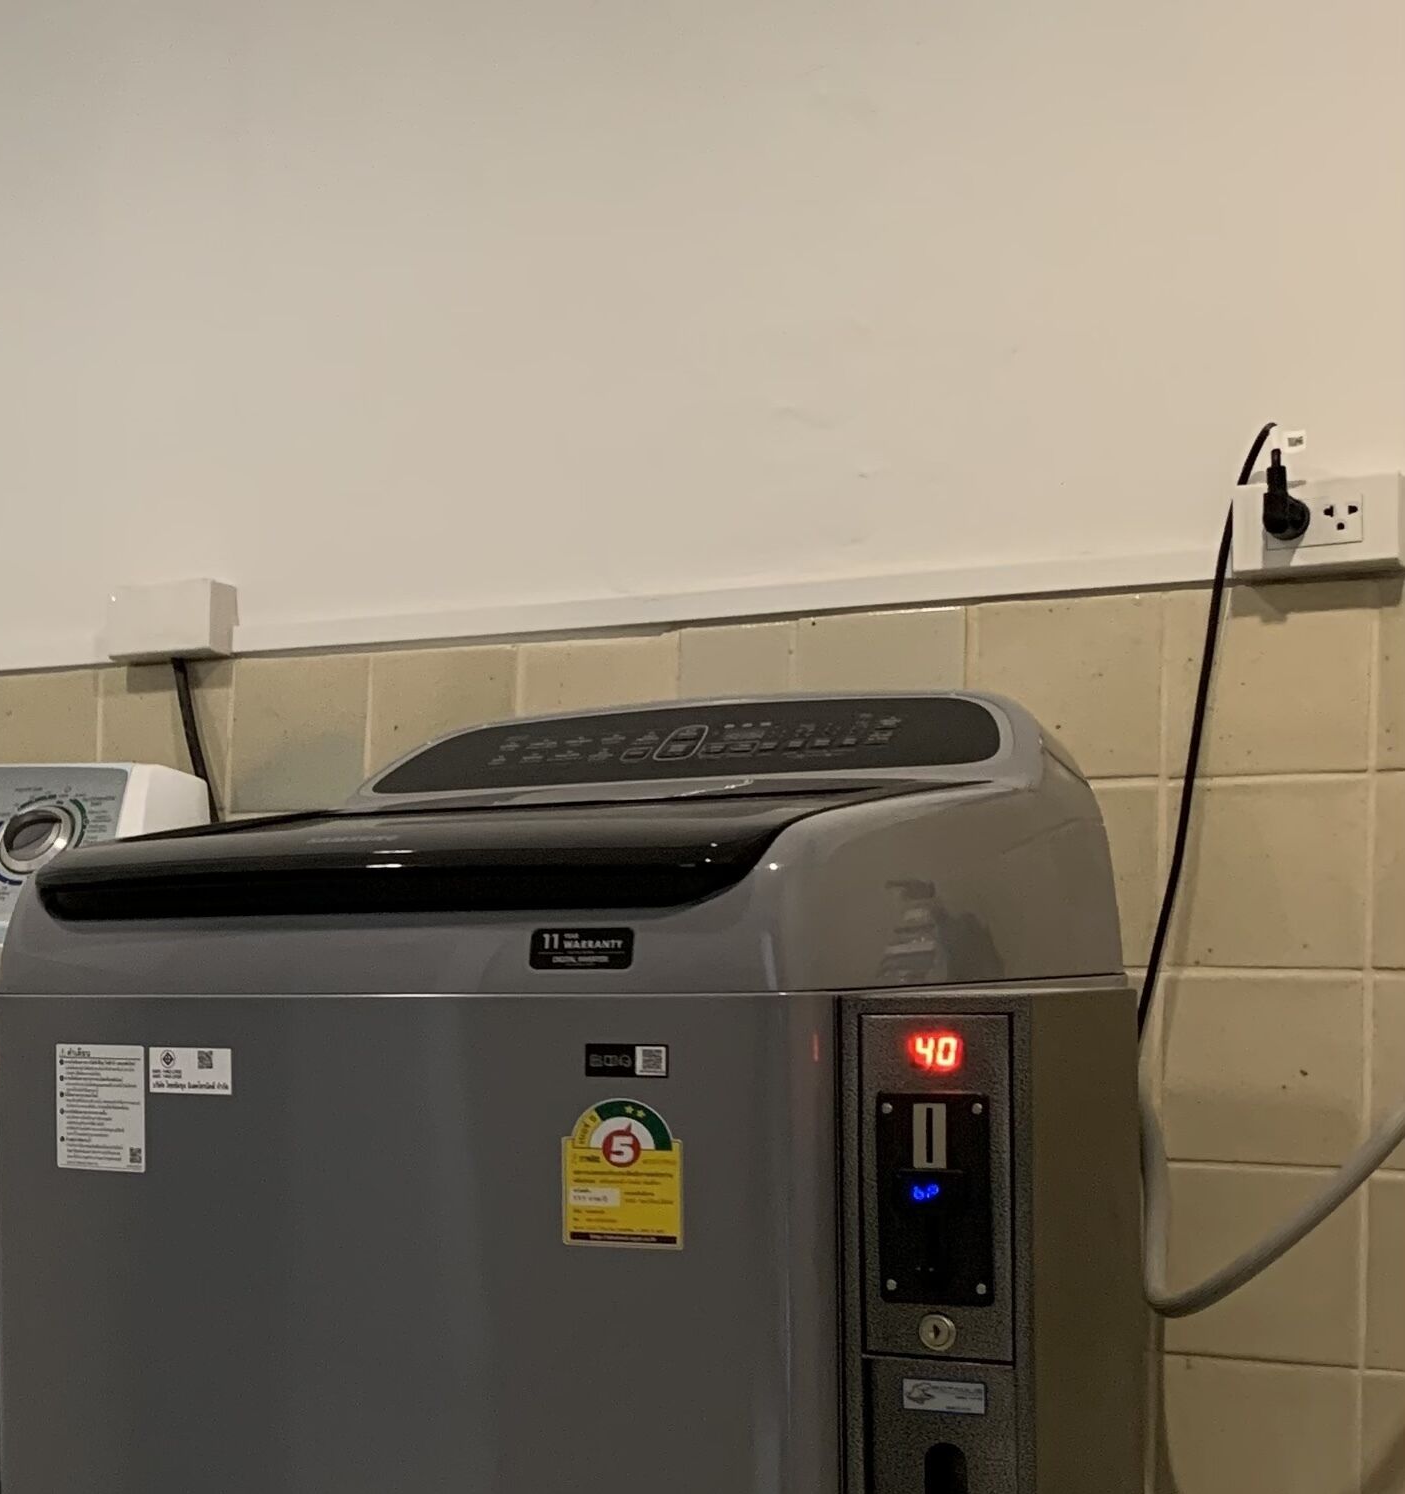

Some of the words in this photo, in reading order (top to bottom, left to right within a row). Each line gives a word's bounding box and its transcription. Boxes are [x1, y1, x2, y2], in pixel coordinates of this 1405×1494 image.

[543, 933, 559, 949] 11
[563, 940, 623, 949] WARRANTY
[914, 1036, 957, 1067] 40
[611, 1136, 634, 1163] 5
